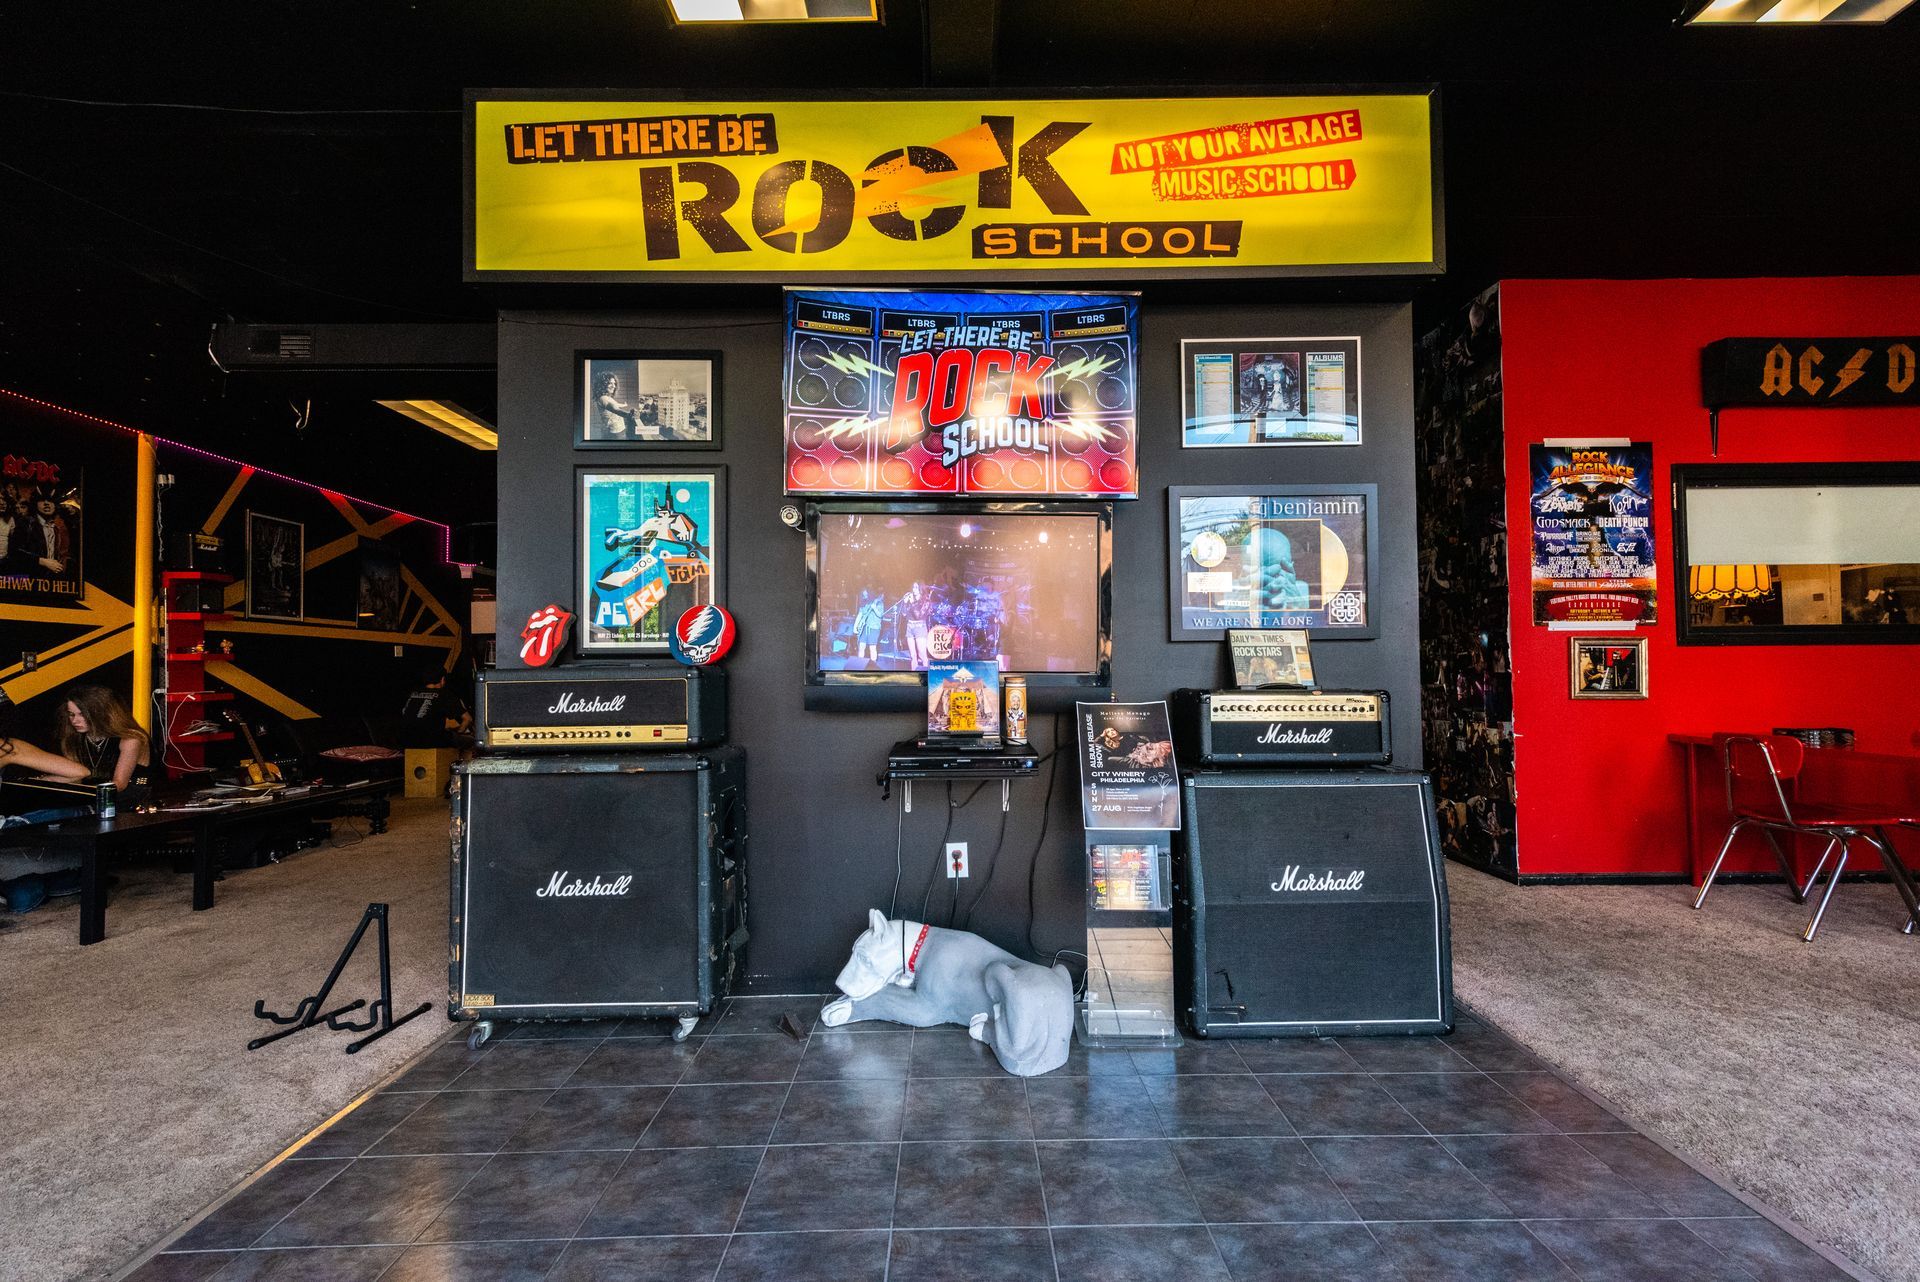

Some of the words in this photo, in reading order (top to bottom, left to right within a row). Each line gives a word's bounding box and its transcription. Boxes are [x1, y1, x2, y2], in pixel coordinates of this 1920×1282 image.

[512, 124, 580, 158] LET
[588, 119, 711, 155] THERE
[717, 118, 767, 153] BE
[1119, 143, 1165, 171] NOT
[1174, 129, 1240, 161] YOUR
[1249, 112, 1359, 151] AVERAGE
[639, 115, 1093, 261] ROCK
[1159, 167, 1240, 197] MUSIC
[1244, 162, 1347, 193] SCHOOL!
[982, 227, 1231, 256] SCHOOL
[822, 310, 851, 321] LTBRS
[907, 317, 936, 328] LTBRS
[1077, 314, 1105, 324] LTBRS
[902, 329, 937, 353] LET
[943, 326, 1003, 347] THERE
[1007, 329, 1033, 351] BE
[1314, 354, 1344, 362] ALBUMS
[887, 348, 1056, 450] ROCK
[942, 417, 1050, 468] SCHOOL
[1572, 451, 1608, 463] ROCK
[1549, 463, 1634, 479] ALLEGIANCE
[1273, 499, 1360, 517] benjamin
[1599, 517, 1622, 528] DEATH
[1623, 517, 1648, 528] PUNCH
[37, 579, 51, 592] TO
[1194, 617, 1213, 626] WE
[1216, 617, 1240, 626] ARE
[1272, 616, 1313, 626] ALONE
[1231, 635, 1250, 644] DAILY
[1262, 635, 1285, 643] TIMES
[1234, 647, 1256, 657] ROCK
[1257, 646, 1283, 657] STARS
[548, 692, 626, 714] Marshall
[1085, 713, 1095, 742] RELEASE
[1257, 723, 1333, 744] Marshall
[1088, 744, 1096, 769] ALBUM
[1095, 745, 1104, 768] SHOW
[536, 871, 632, 897] Marshall
[1271, 865, 1365, 891] Marshall
